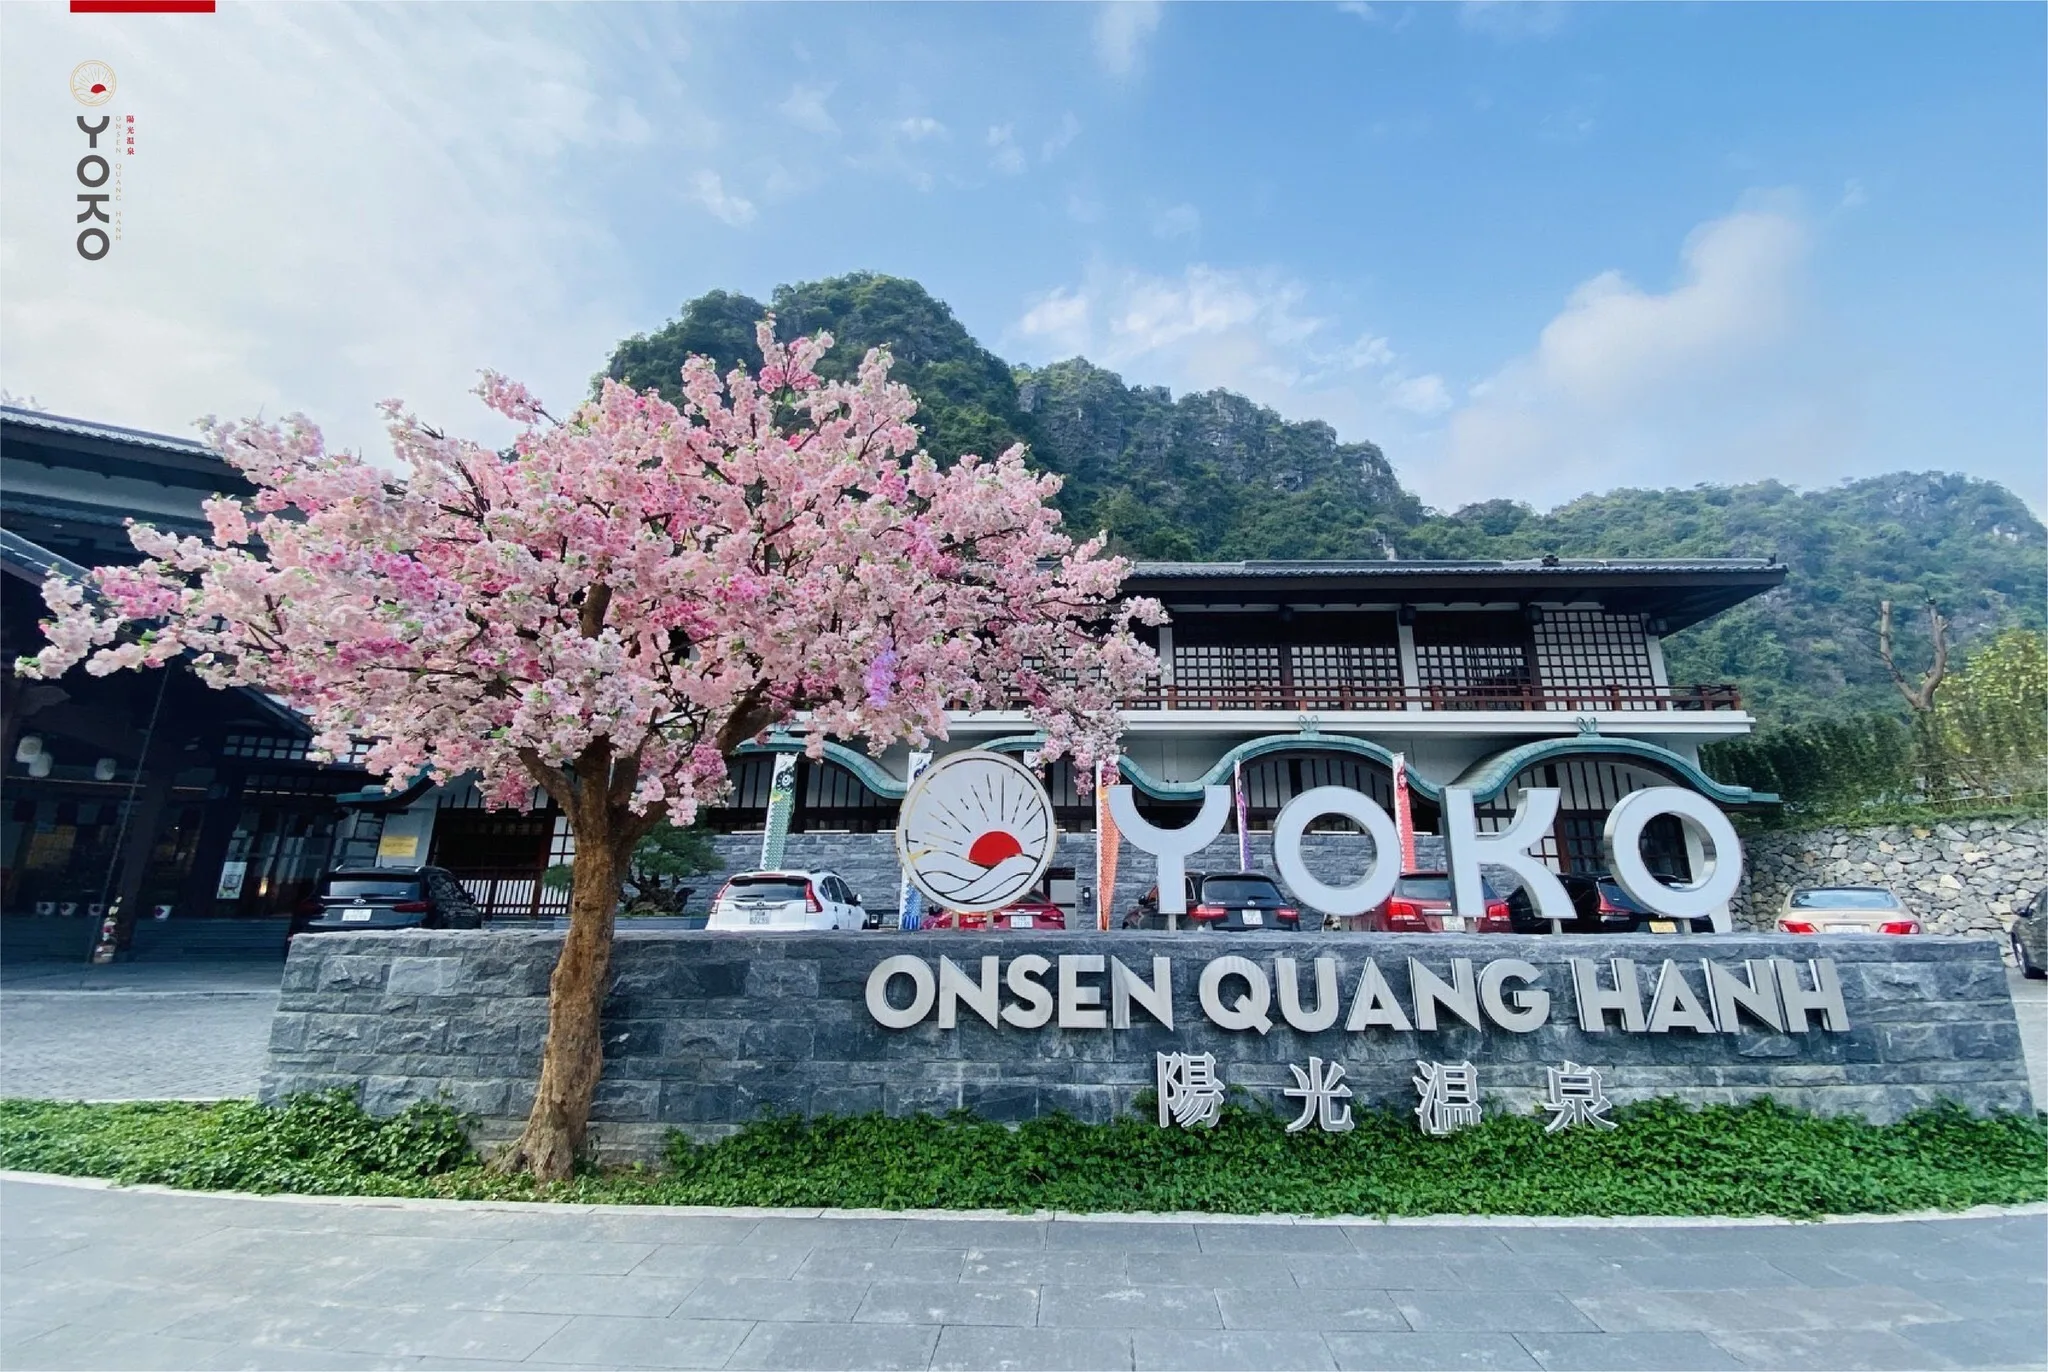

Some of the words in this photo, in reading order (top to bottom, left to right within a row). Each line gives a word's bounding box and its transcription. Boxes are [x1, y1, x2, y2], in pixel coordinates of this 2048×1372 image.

[1109, 785, 1743, 919] YOKO
[865, 954, 1174, 1030] ONSEN
[1200, 955, 1550, 1033] QUANG
[1570, 957, 1850, 1033] HANH
